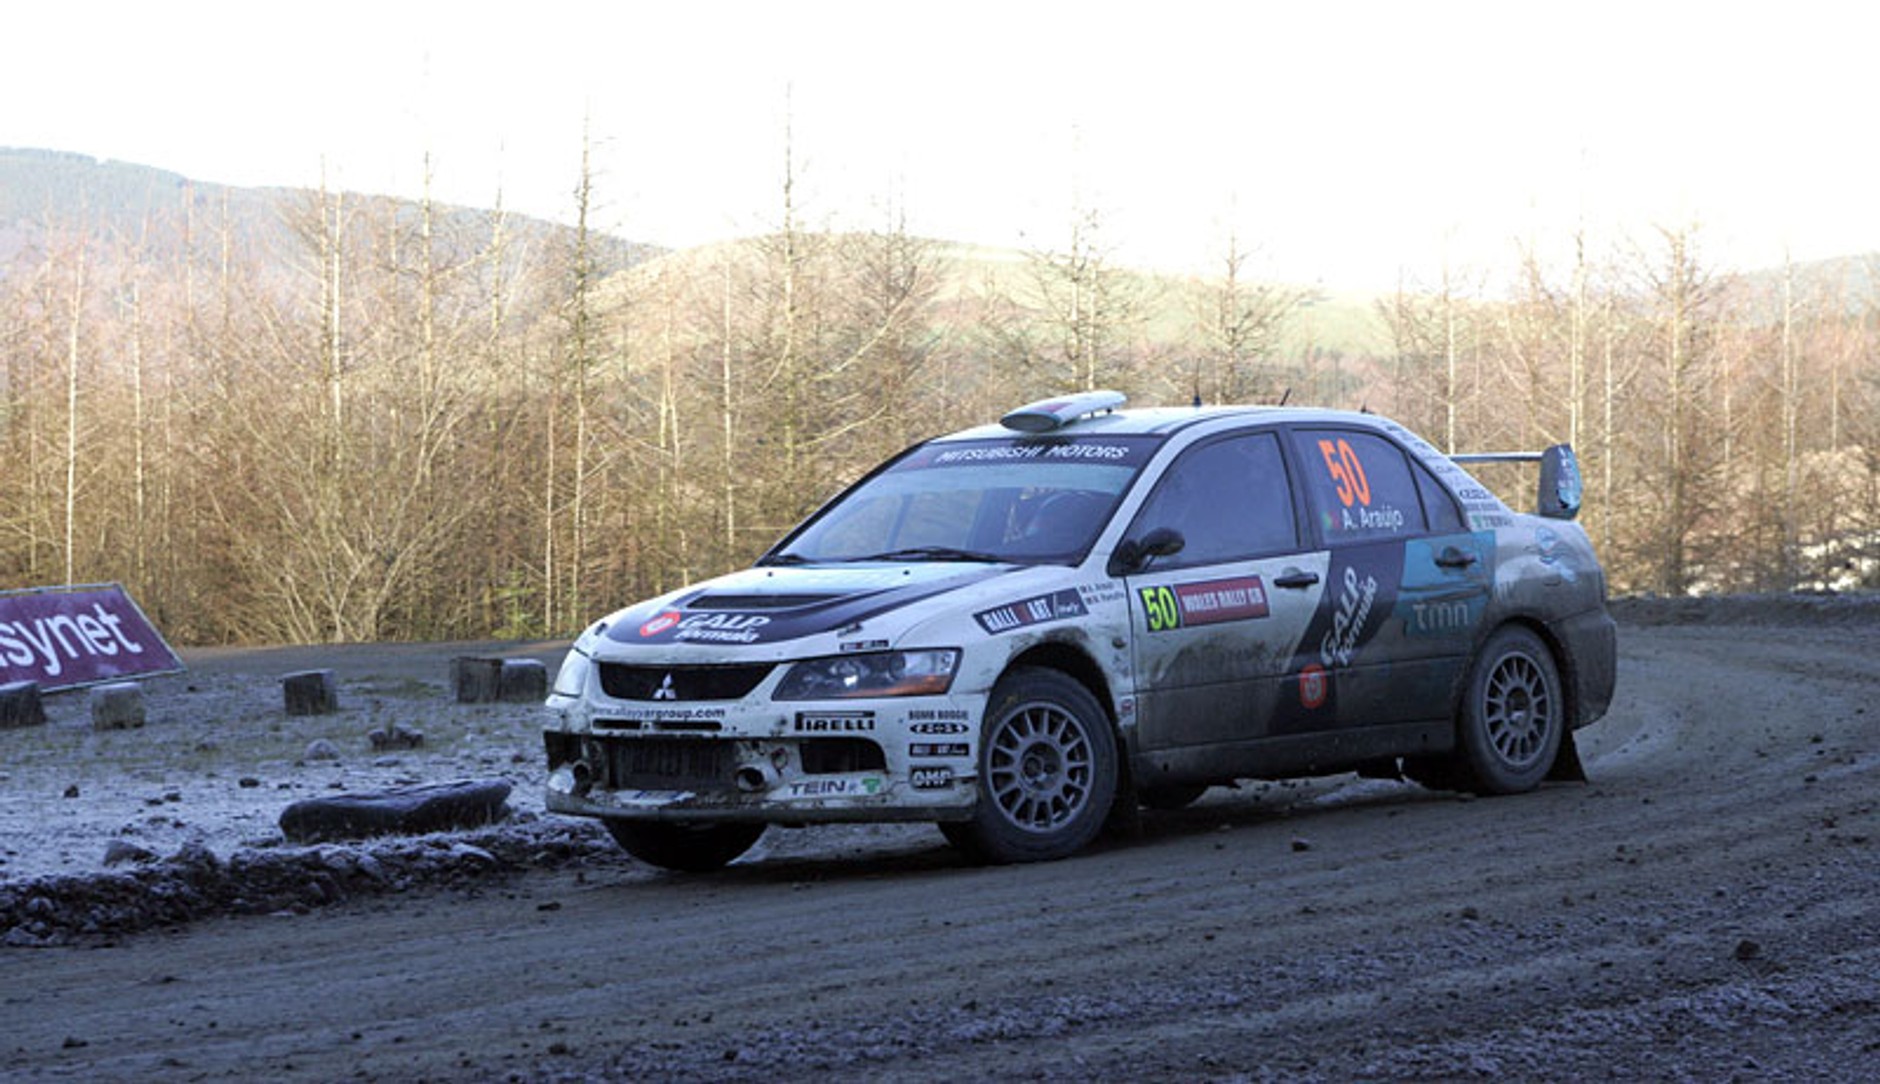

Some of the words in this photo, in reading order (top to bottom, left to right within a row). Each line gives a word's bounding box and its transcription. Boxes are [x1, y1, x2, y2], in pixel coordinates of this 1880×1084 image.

[935, 445, 1044, 464] MITSUBISHI
[1045, 444, 1130, 459] MOTORS
[1318, 438, 1371, 507] 50
[1342, 508, 1359, 529] A.
[1360, 504, 1404, 533] Araújo
[677, 613, 772, 629] GALP
[1142, 585, 1179, 631] 50
[1181, 592, 1219, 613] WALES
[1217, 588, 1247, 609] RALLY
[1321, 566, 1360, 667] GALP
[1412, 602, 1469, 630] tmn
[0, 603, 143, 676] synet
[795, 711, 876, 731] PIRELLI
[789, 779, 847, 796] TEIN
